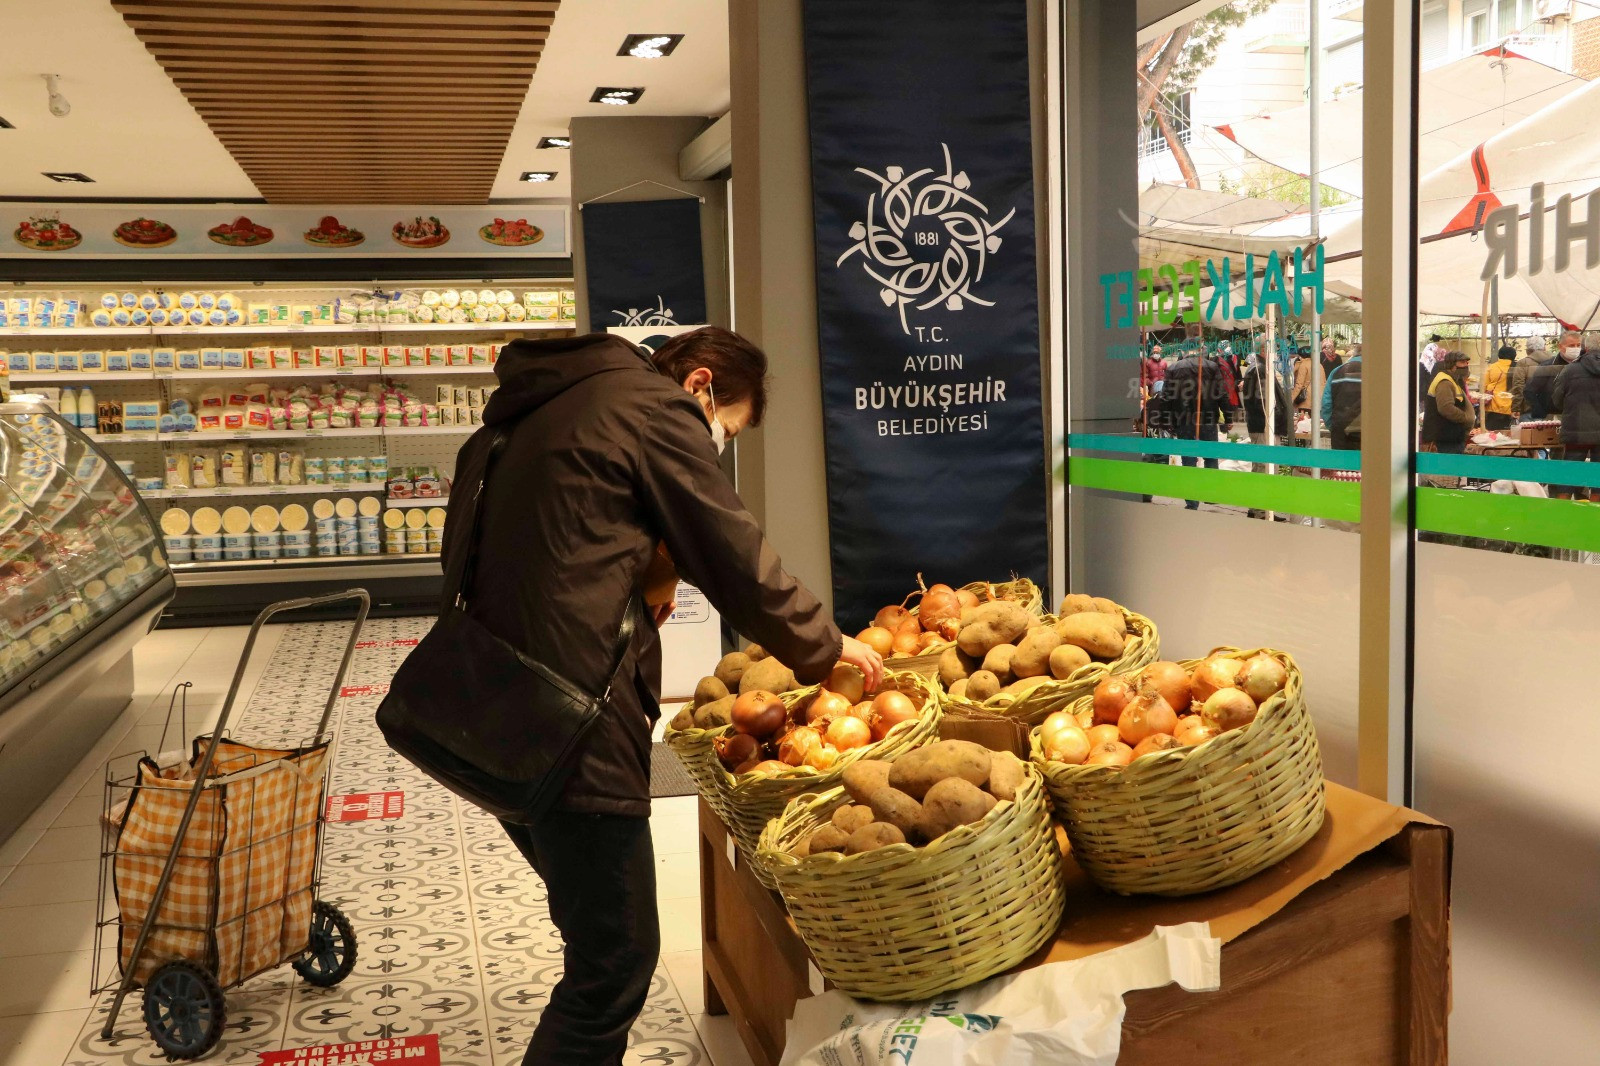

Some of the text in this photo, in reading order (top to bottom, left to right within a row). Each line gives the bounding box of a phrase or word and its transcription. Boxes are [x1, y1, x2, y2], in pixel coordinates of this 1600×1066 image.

[914, 231, 940, 246] 1881
[914, 326, 950, 343] T.C.
[903, 354, 964, 373] AYDIN
[855, 376, 1007, 413] BÜYÜKŞEHİR
[877, 410, 989, 437] BELEDİYESİ
[294, 1038, 406, 1059] KORUYUN
